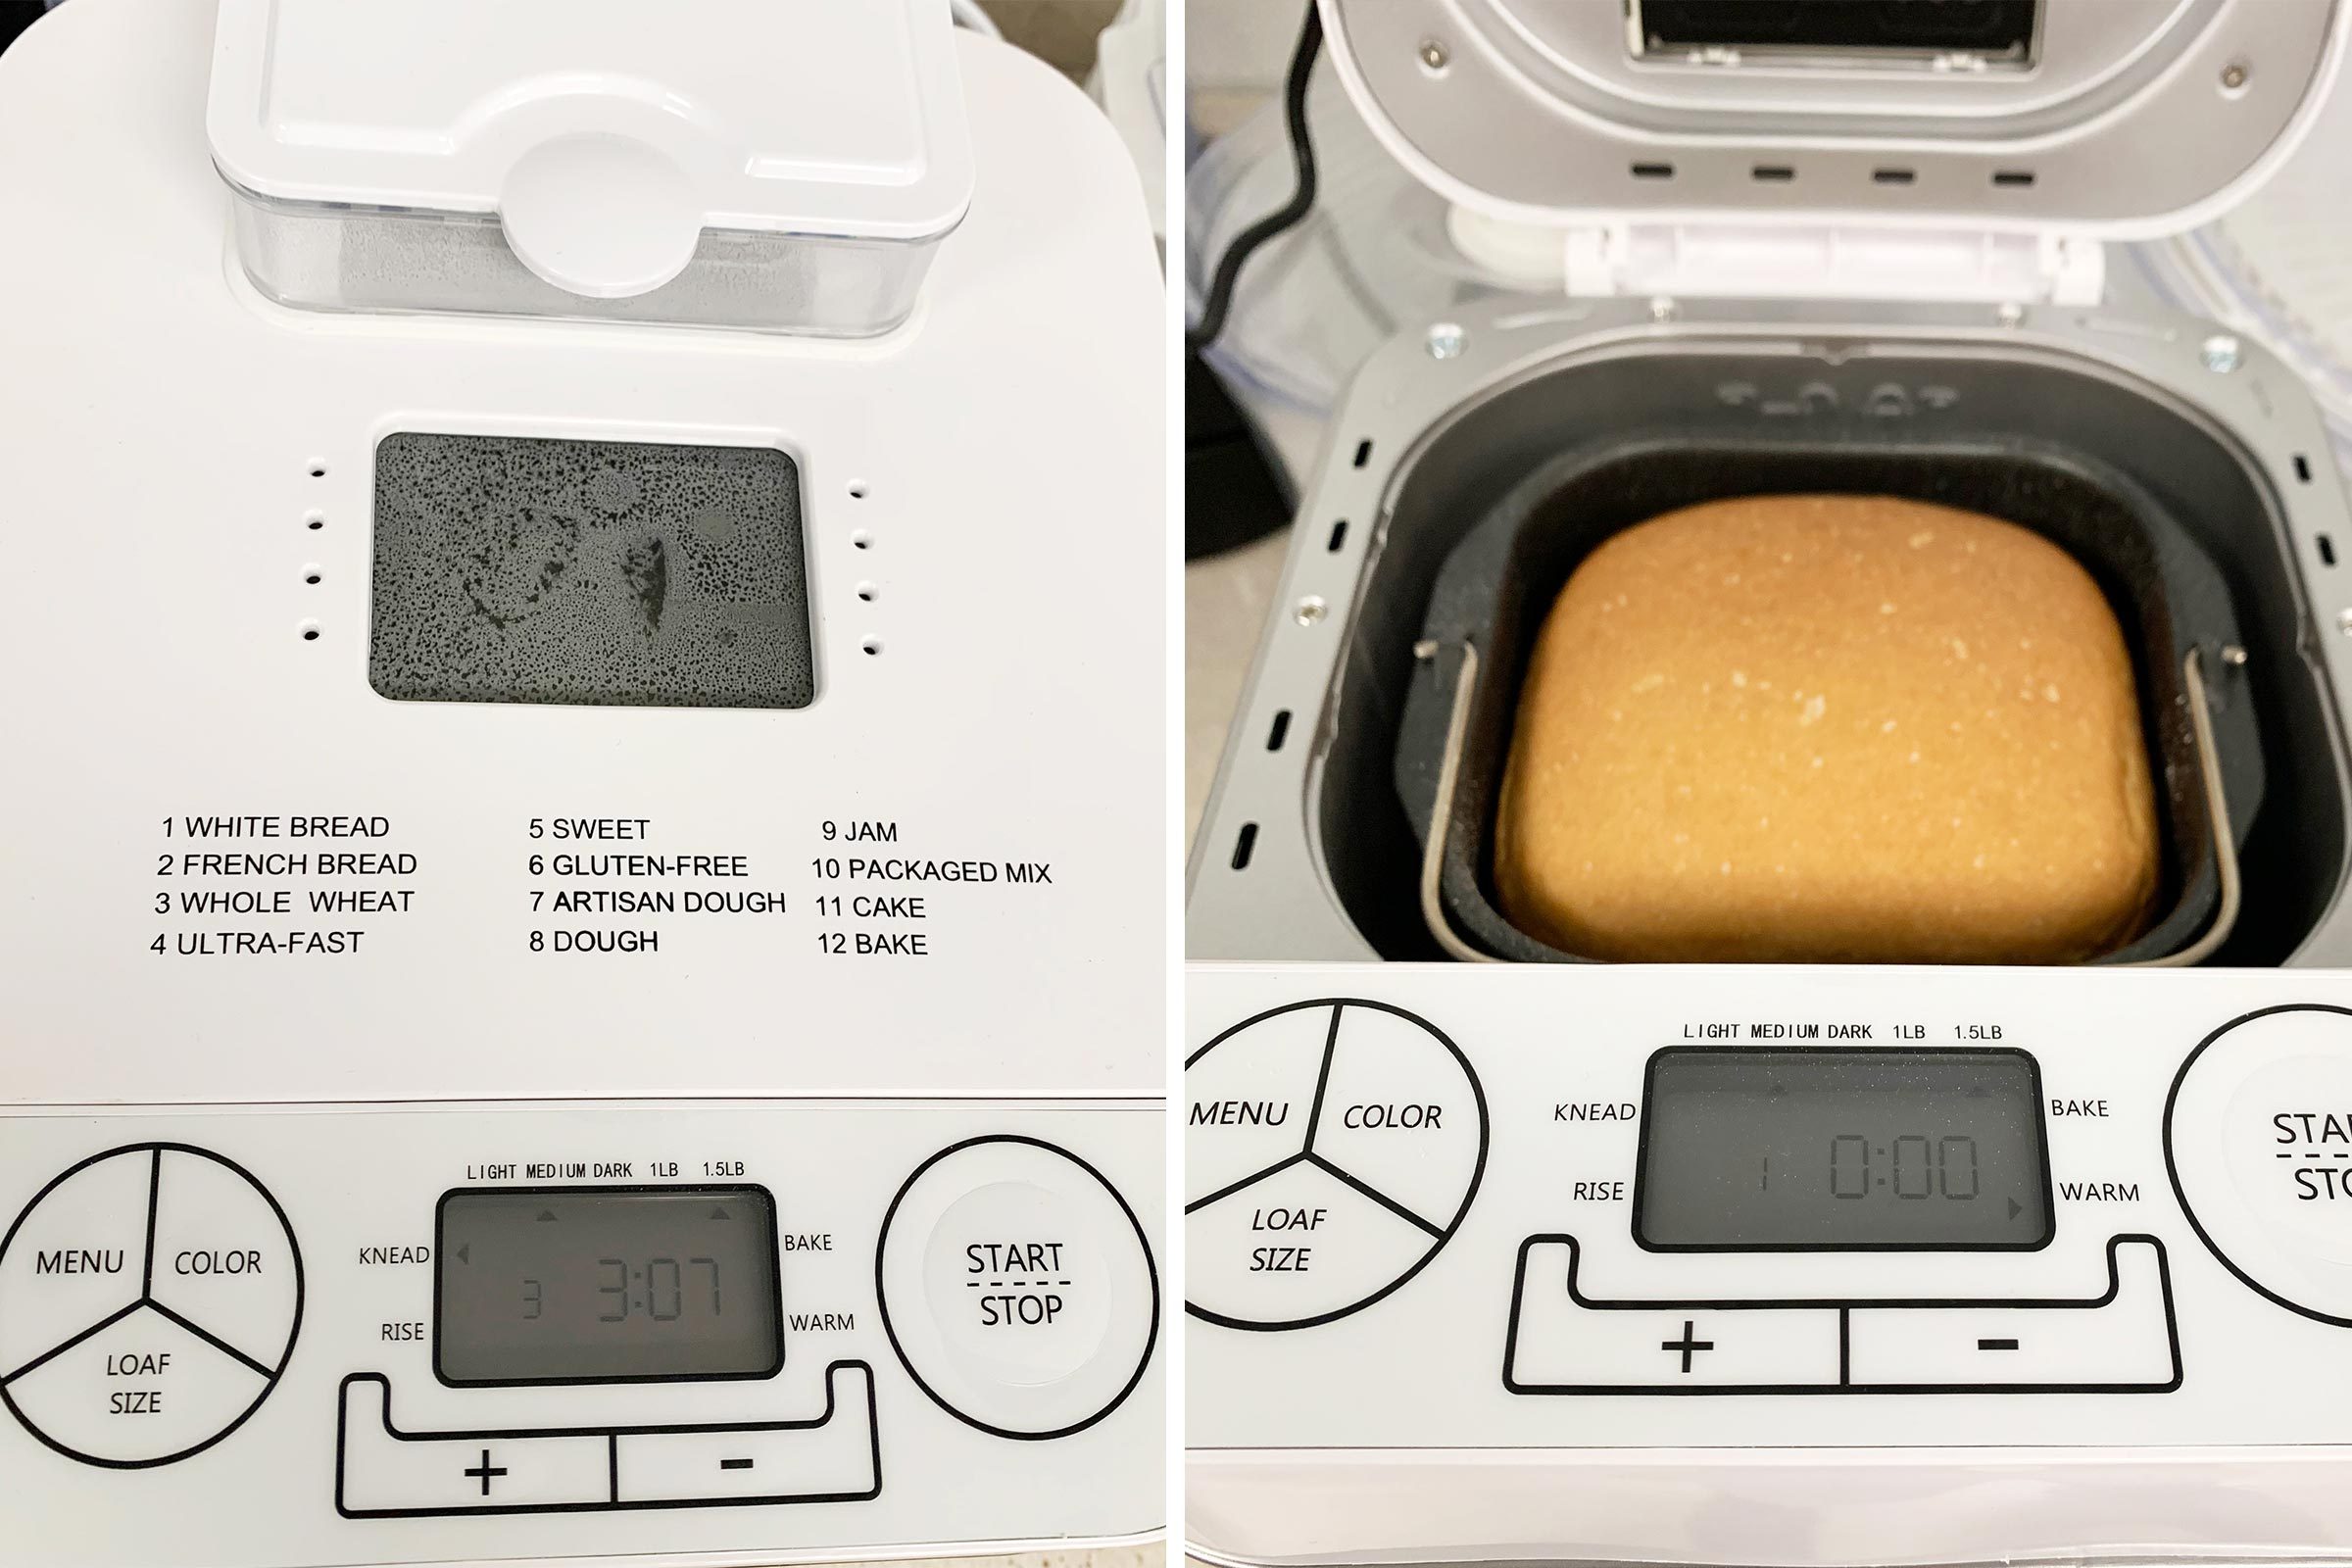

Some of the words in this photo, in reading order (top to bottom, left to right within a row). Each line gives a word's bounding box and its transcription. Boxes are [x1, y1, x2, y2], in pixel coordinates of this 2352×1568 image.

[185, 816, 280, 838] WHITE
[290, 816, 390, 838] BREAD
[529, 818, 544, 839] 5
[552, 817, 651, 840] SWEET
[821, 820, 837, 841] 9
[844, 820, 898, 843] JAM
[157, 854, 174, 876] 2
[183, 853, 308, 876] FRENCH
[318, 853, 417, 875] BREAD
[528, 854, 544, 876] 6
[553, 854, 749, 877] GLUTEN-FREE
[811, 858, 841, 879] 10
[849, 858, 998, 883] PACKAGED
[1004, 862, 1053, 884] MIX
[154, 892, 171, 914] 3
[180, 891, 291, 914] WHOLE
[309, 890, 416, 913] WHEAT
[529, 891, 545, 912] 7
[553, 890, 674, 913] ARTISAN
[684, 891, 786, 913] DOUGH
[815, 895, 841, 917] 11
[853, 896, 927, 918] CAKE
[150, 933, 167, 956] 4
[177, 931, 365, 956] ULTRA-FAST
[529, 930, 545, 953] 8
[554, 929, 659, 953] DOUGH
[817, 932, 847, 955] 12
[855, 933, 929, 956] BAKE
[1684, 1023, 1740, 1039] LIGHT
[1750, 1023, 1819, 1039] MEDIUM
[1828, 1024, 1873, 1039] DARK
[1892, 1024, 1926, 1040] 1LB
[1954, 1025, 2002, 1040] 1.5LB
[1189, 1101, 1289, 1127] MENU
[1344, 1103, 1443, 1129] COLOR
[1554, 1102, 1637, 1121] KNEAD
[2051, 1099, 2110, 1117] BAKE
[2273, 1113, 2352, 1145] STA
[467, 1163, 517, 1180] LIGHT
[525, 1162, 586, 1179] MEDIUM
[593, 1162, 633, 1178] DARK
[650, 1161, 679, 1177] 1LB
[703, 1161, 745, 1177] 1.5LB
[1830, 1134, 1980, 1200] 0:00
[1573, 1181, 1625, 1201] RISE
[2059, 1182, 2140, 1201] WARM
[1251, 1207, 1328, 1231] LOAF
[784, 1234, 833, 1251] BAKE
[36, 1250, 124, 1275] MENU
[174, 1250, 262, 1276] COLOR
[359, 1246, 430, 1265] KNEAD
[966, 1243, 1063, 1274] START
[1249, 1247, 1312, 1272] SIZE
[523, 1280, 541, 1319] 3
[599, 1258, 721, 1322] 3:07
[980, 1295, 1063, 1326] STOP
[381, 1322, 424, 1342] RISE
[789, 1313, 855, 1332] WARM
[107, 1353, 172, 1376] LOAF
[109, 1391, 162, 1415] SIZE
